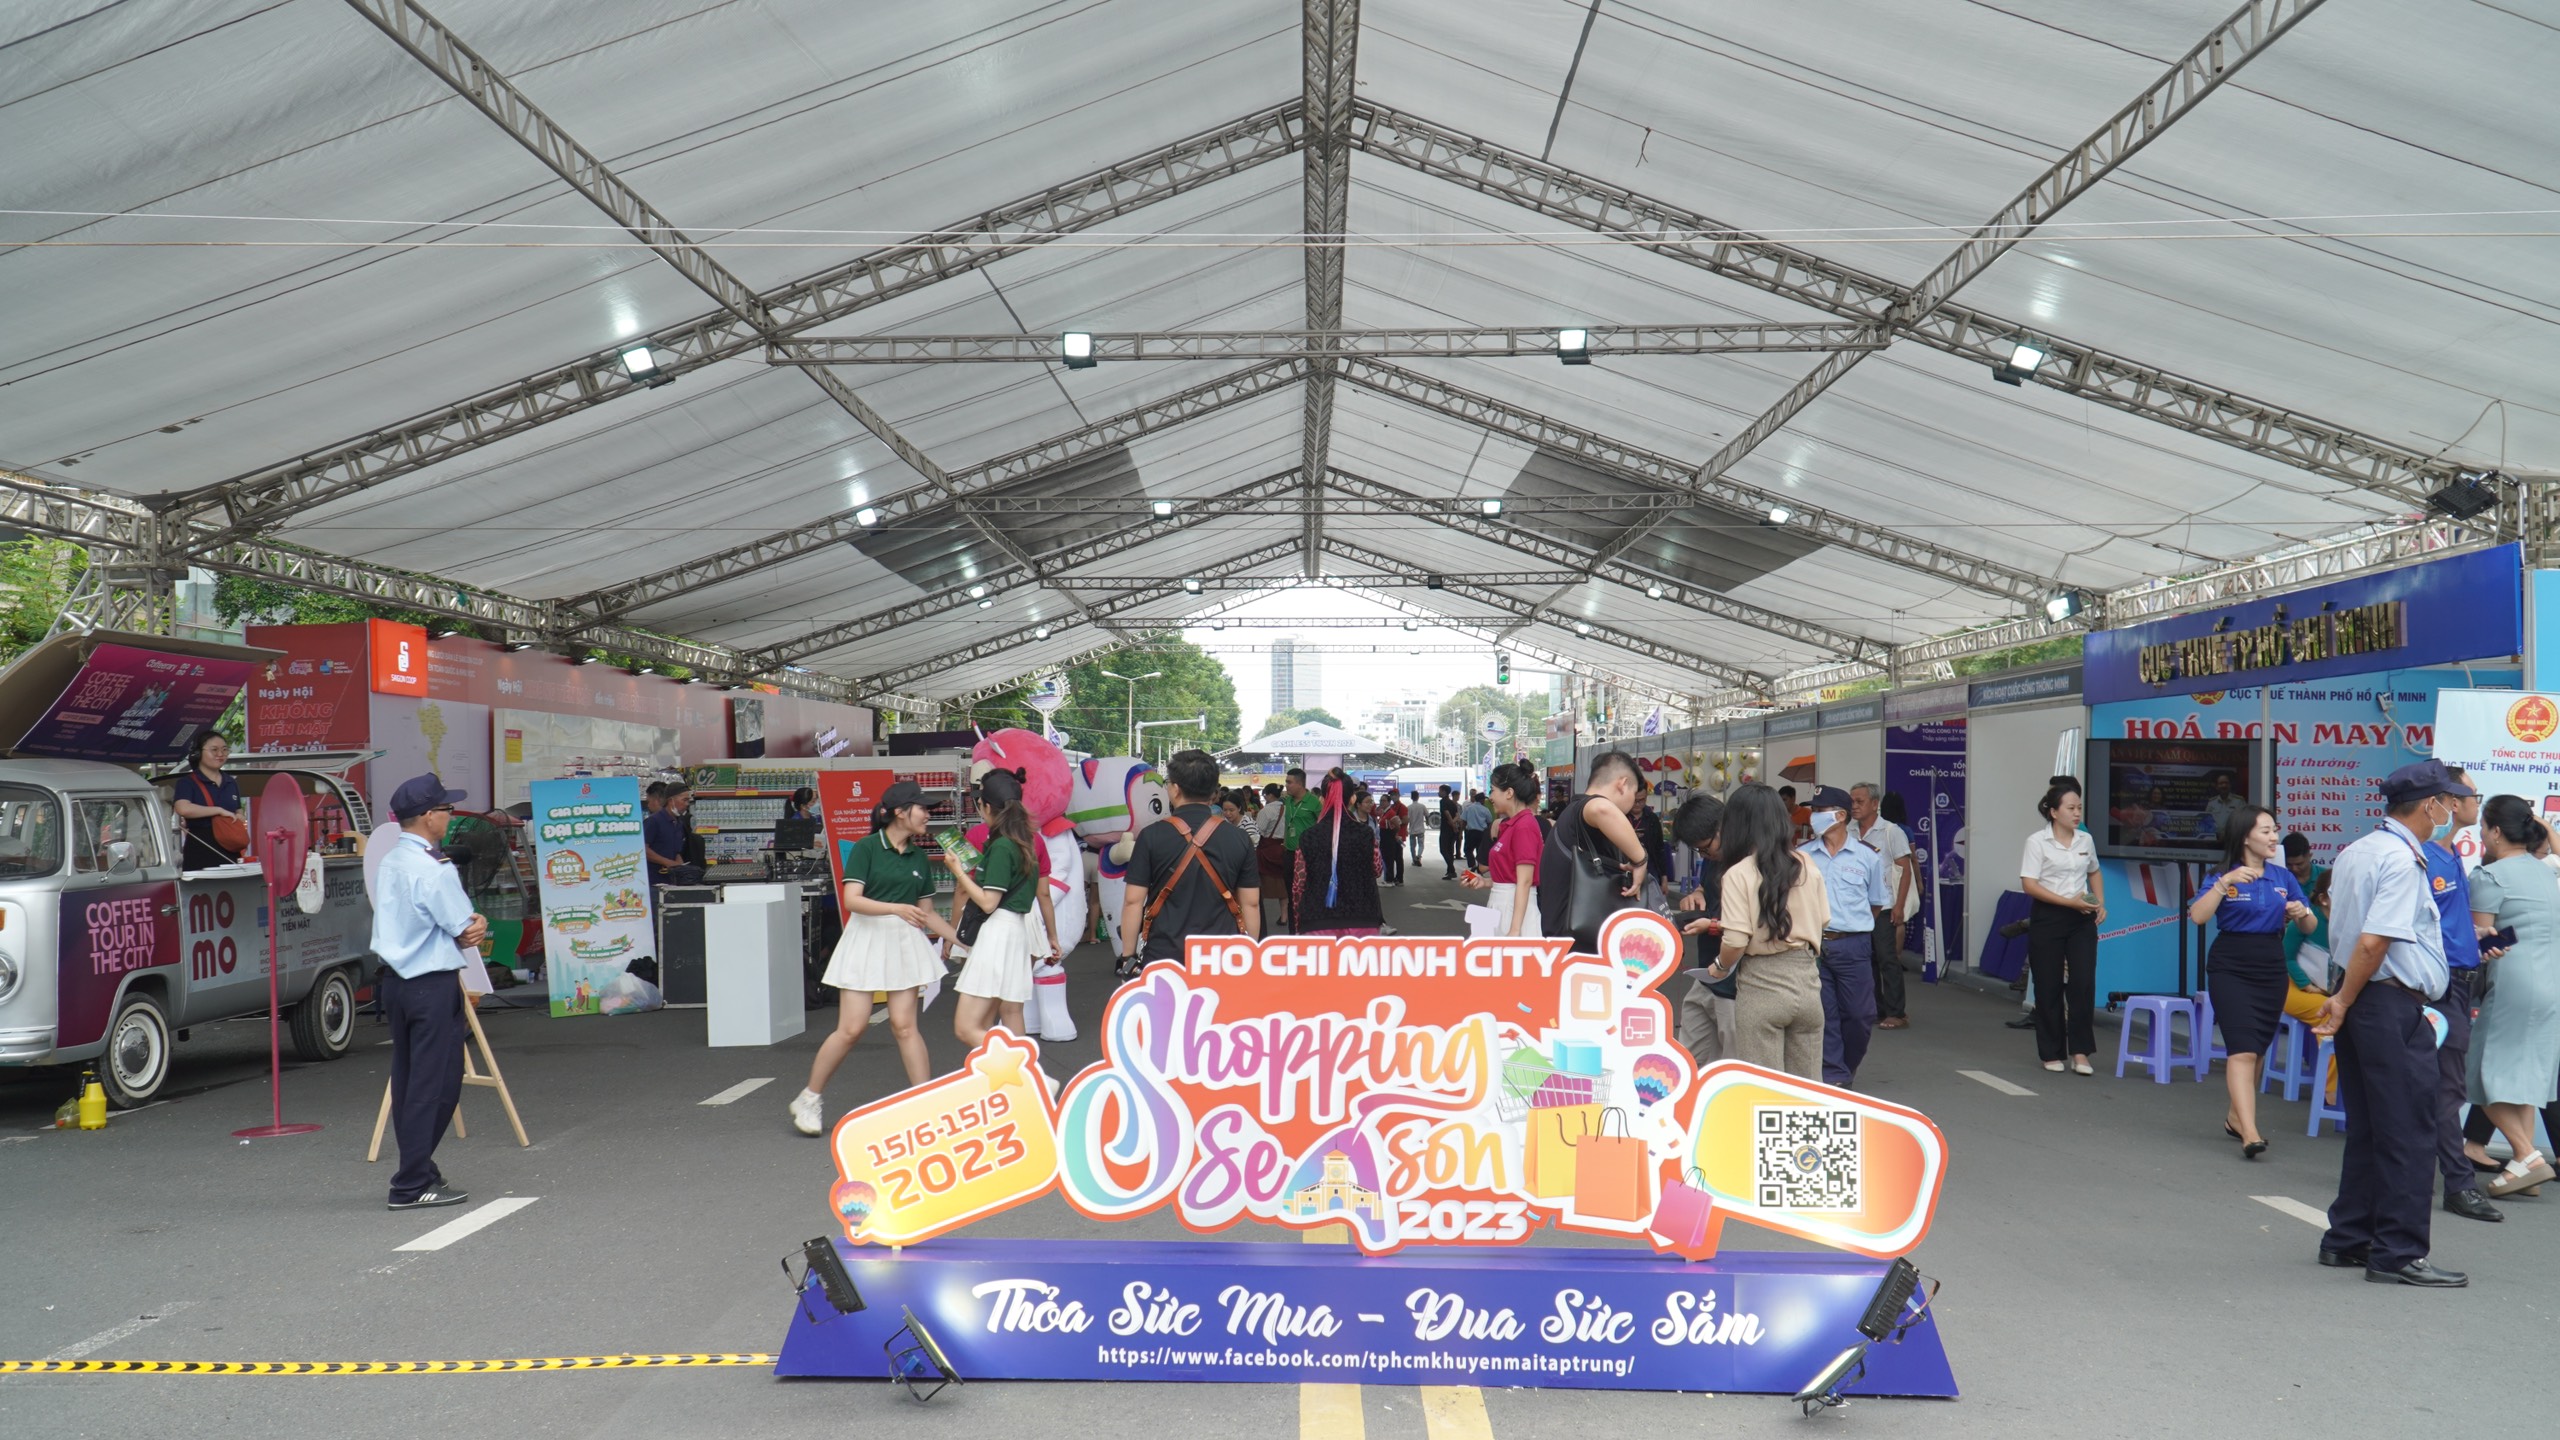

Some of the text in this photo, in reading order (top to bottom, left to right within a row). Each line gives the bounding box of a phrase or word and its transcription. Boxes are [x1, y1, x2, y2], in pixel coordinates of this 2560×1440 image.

[87, 671, 134, 687] COFFEE
[80, 684, 110, 698] TOUR
[259, 686, 313, 699] Ngày Hội
[2229, 688, 2252, 701] CỤC
[2254, 686, 2286, 701] TUẾ
[2288, 687, 2327, 701] THÀNH
[2329, 687, 2353, 702] PHỐ
[2356, 687, 2372, 702] HỒ
[2398, 692, 2427, 703] MINH
[70, 695, 119, 710] THE CITY
[260, 700, 334, 720] KHÔNG
[2125, 714, 2207, 740] HOÁ
[2314, 723, 2393, 747] MAY
[1271, 740, 1311, 748] CASHLESS
[2492, 746, 2516, 759] TỔNG
[2518, 751, 2537, 760] CỤC
[2301, 757, 2361, 770] thưởng:
[2491, 760, 2525, 773] THÀNH
[2529, 761, 2552, 774] PHỐ
[2287, 776, 2315, 787] giải
[2321, 774, 2360, 786] Nhất:
[2287, 791, 2315, 802] giải
[2321, 791, 2346, 801] Nhì
[549, 802, 632, 818] GIA ĐÌNH VIỆT
[2287, 806, 2316, 817] giải
[2322, 807, 2340, 817] Ba
[543, 818, 640, 841] ĐẠI SỨ XANH
[2287, 822, 2316, 833] giải
[2321, 823, 2342, 832] KK
[551, 864, 581, 874] HOT
[86, 897, 153, 928] COFFEE
[88, 921, 155, 952] TOUR IN
[90, 945, 155, 975] THE CITY
[1190, 944, 1562, 978] HO CHI MINH CITY
[1063, 974, 1490, 1208] Shopping
[866, 1092, 1010, 1167] 15/6-15/9
[881, 1122, 1026, 1211] 2023
[1399, 1199, 1529, 1241] 2023
[972, 1279, 1095, 1335] Thỏa
[1108, 1280, 1202, 1337] Sức
[1218, 1285, 1342, 1346] Mua
[1405, 1287, 1526, 1342] Đua
[1540, 1288, 1636, 1345] Sức
[1651, 1289, 1765, 1346] Sắm
